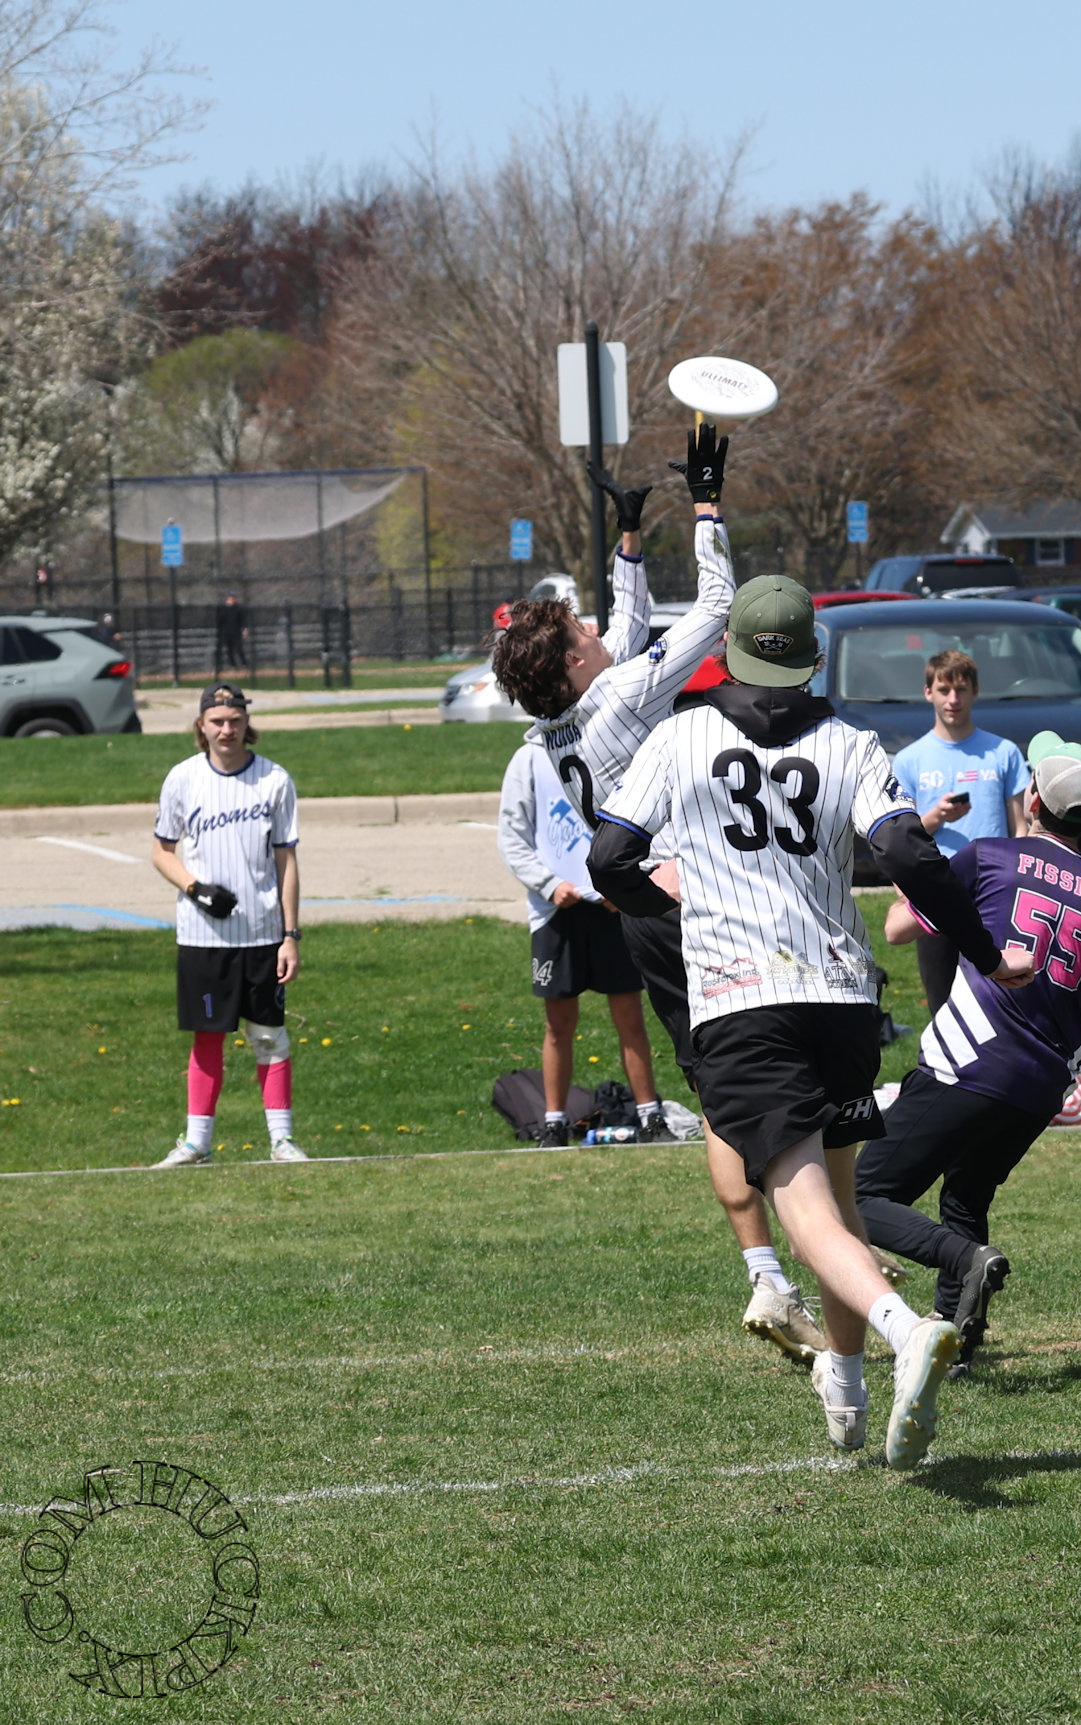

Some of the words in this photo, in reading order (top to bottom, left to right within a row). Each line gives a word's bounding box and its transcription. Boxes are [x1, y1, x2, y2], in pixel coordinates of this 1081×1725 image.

[702, 466, 713, 480] 2
[919, 770, 944, 791] 50
[712, 747, 820, 857] 33
[188, 801, 271, 848] Gnomes
